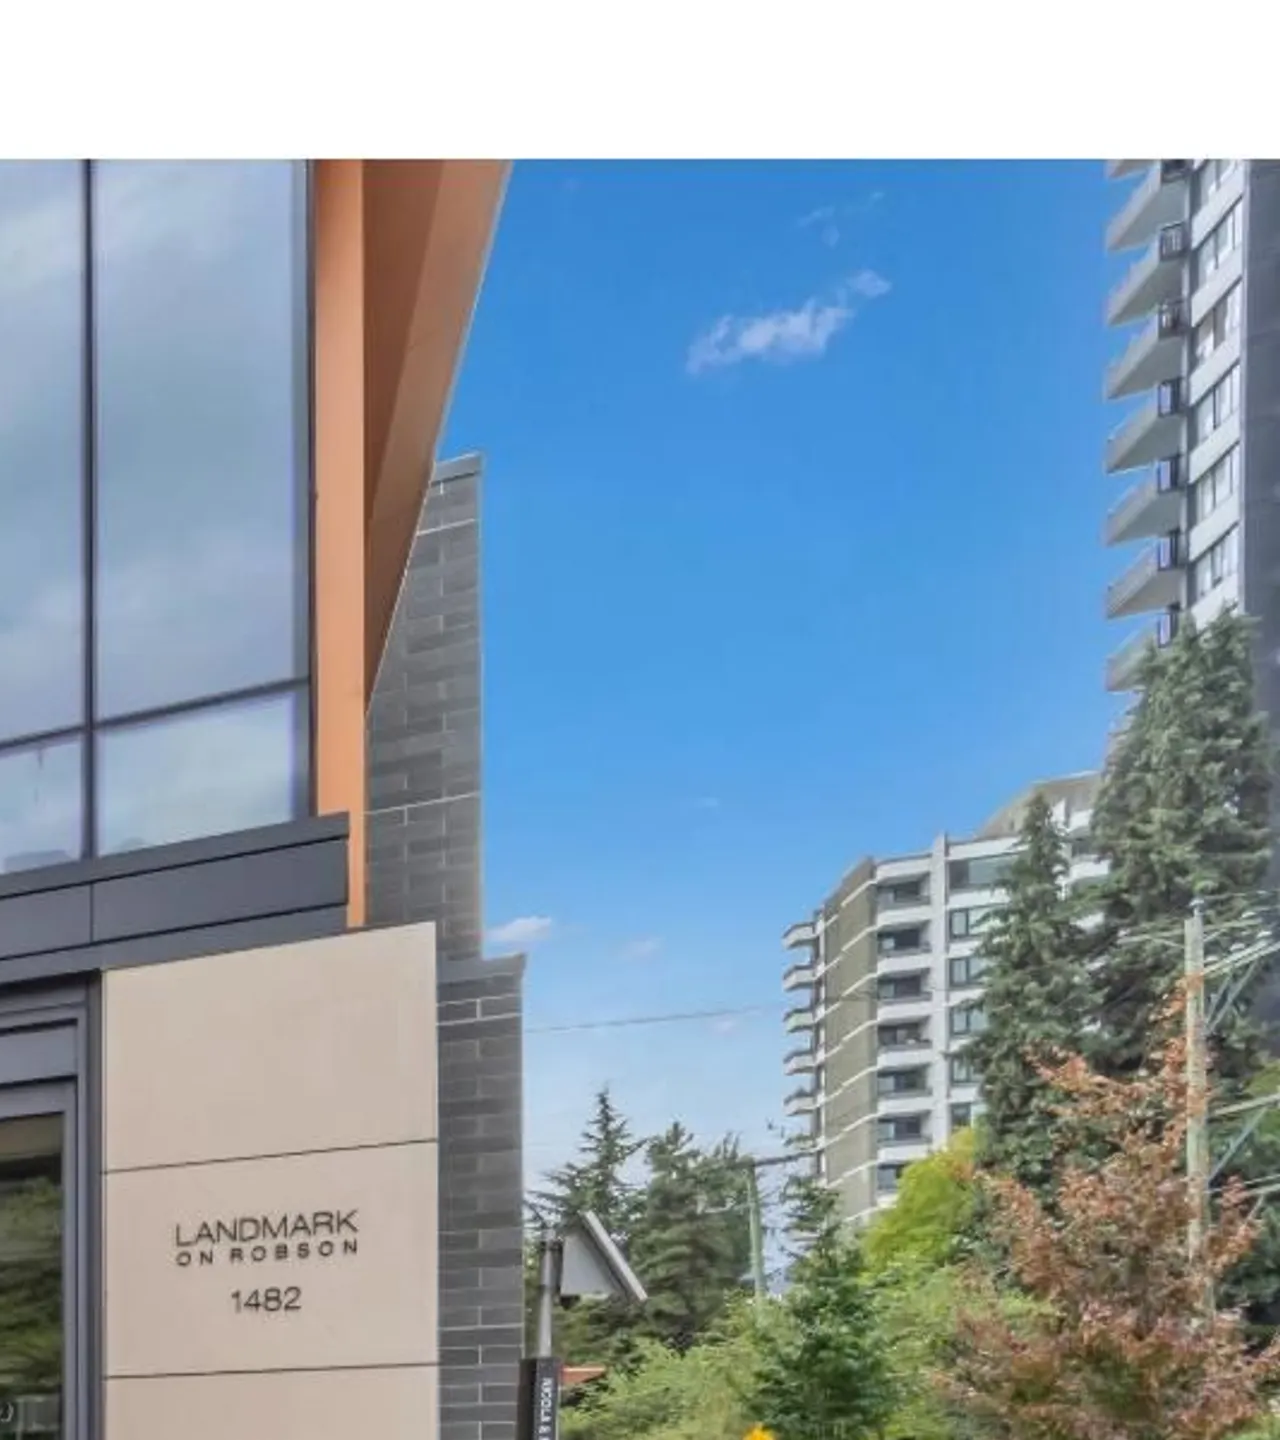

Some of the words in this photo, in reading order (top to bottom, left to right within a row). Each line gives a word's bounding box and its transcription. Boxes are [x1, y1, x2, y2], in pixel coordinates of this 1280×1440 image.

[175, 1208, 359, 1248] LANDMARK
[175, 1250, 214, 1267] ON
[230, 1238, 358, 1265] ROBSON
[230, 1285, 303, 1314] 1482
